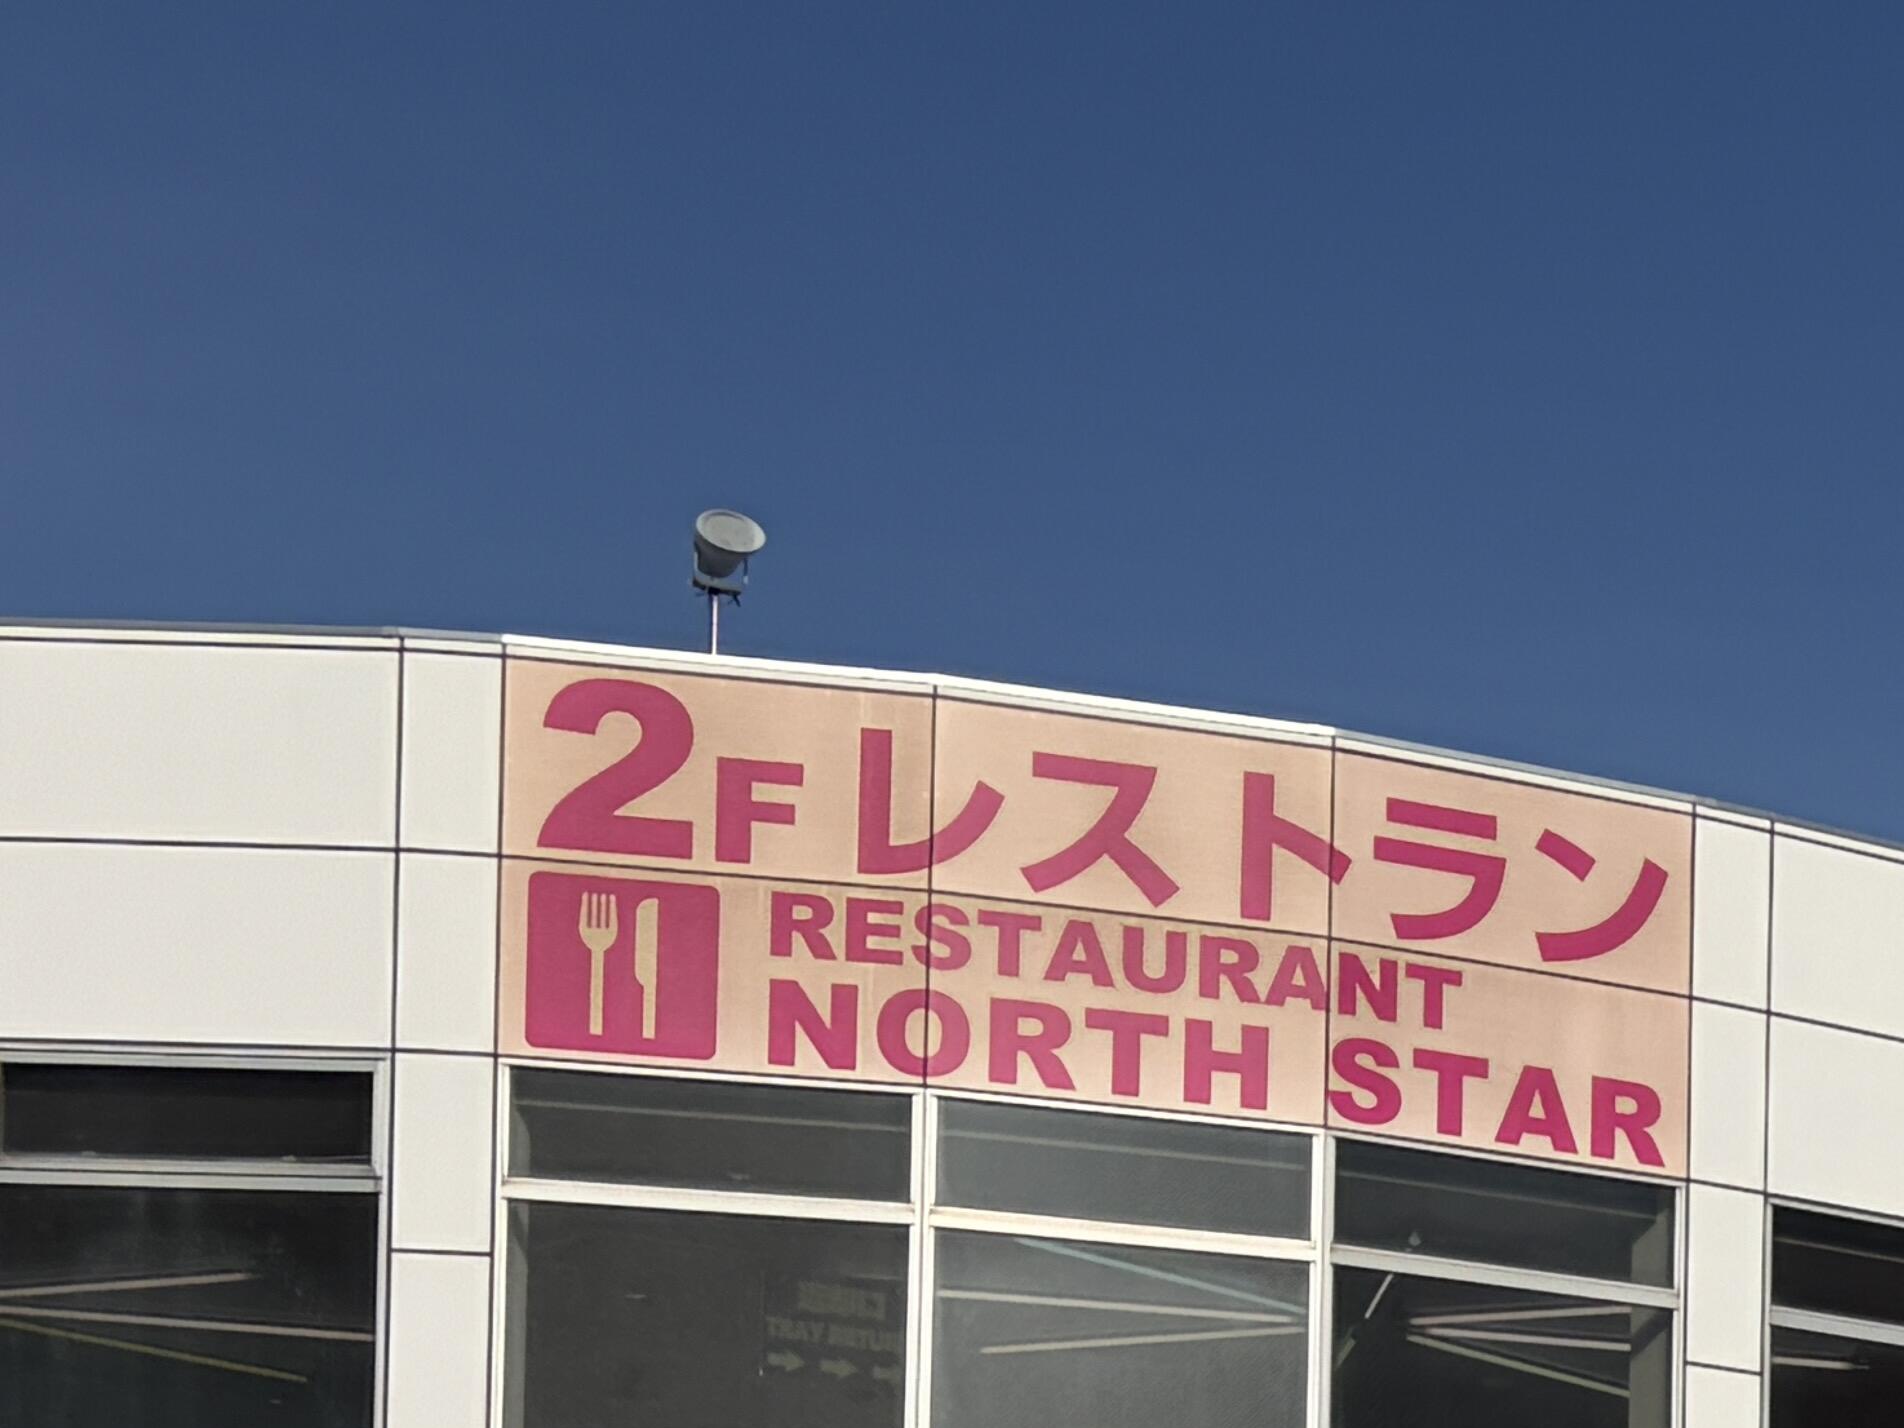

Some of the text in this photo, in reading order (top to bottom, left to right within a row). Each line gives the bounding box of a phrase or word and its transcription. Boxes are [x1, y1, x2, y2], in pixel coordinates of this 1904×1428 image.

[770, 891, 1463, 1031] RESTAURANT
[767, 978, 1667, 1169] NORTH STAR
